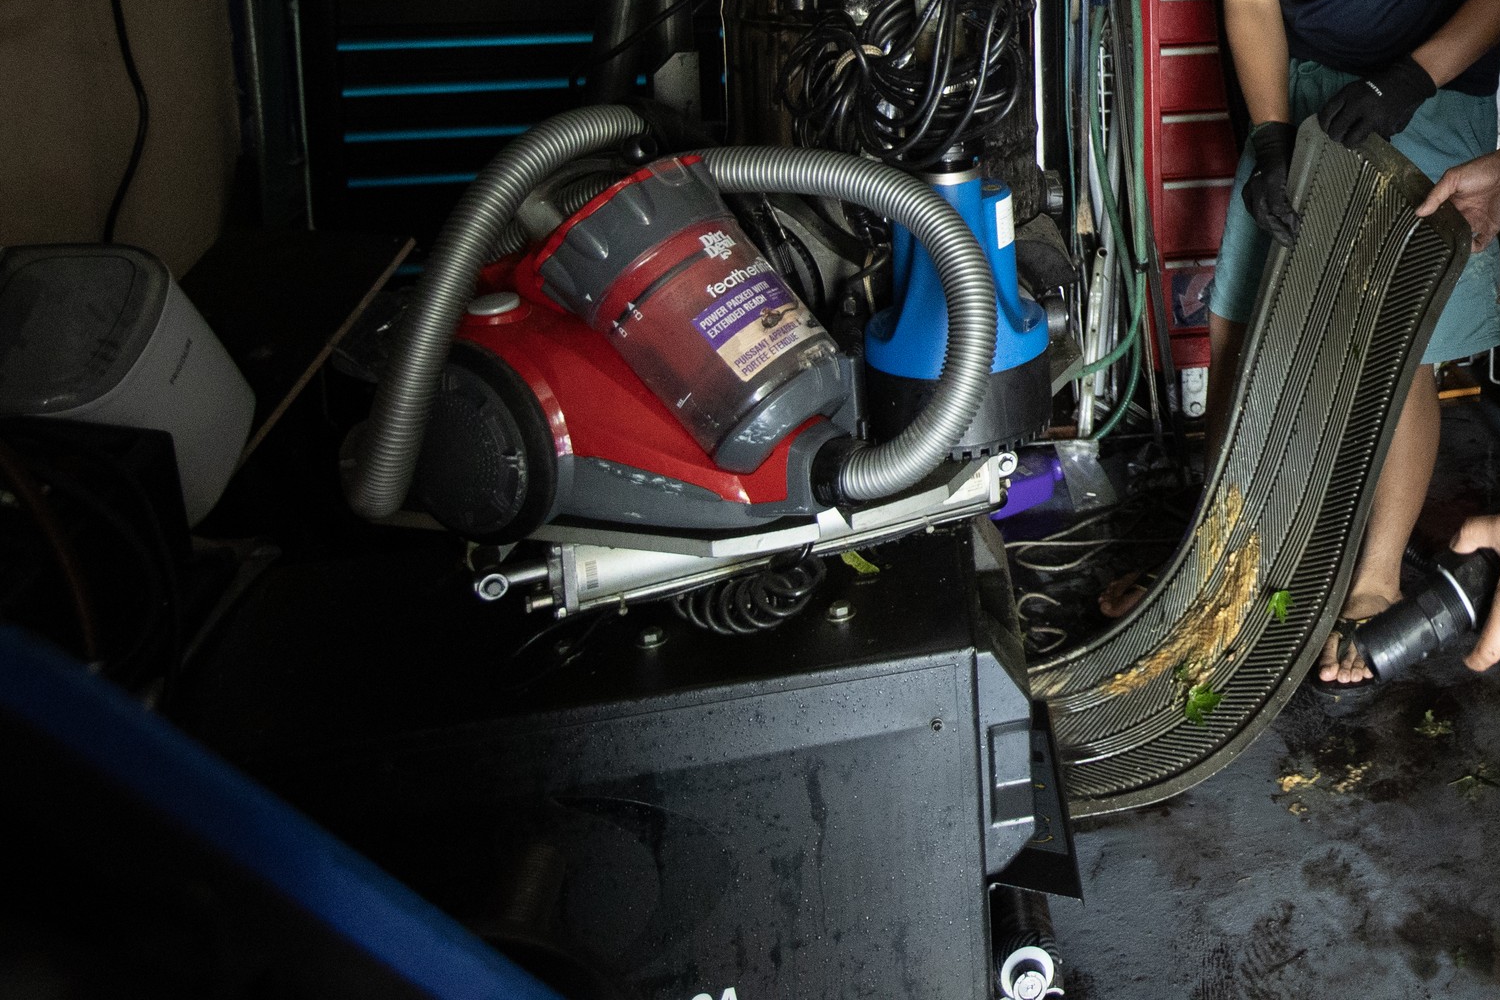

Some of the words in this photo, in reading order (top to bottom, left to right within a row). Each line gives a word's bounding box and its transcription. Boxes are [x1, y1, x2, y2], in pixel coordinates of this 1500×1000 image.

[699, 230, 726, 249] Dirt
[704, 235, 736, 259] Devil
[700, 305, 729, 330] POWER
[726, 288, 755, 310] PACKED
[751, 280, 770, 294] WITH
[707, 307, 746, 339] EXTENDED
[743, 294, 767, 312] REACH
[734, 338, 769, 368] PUISSANT
[769, 321, 798, 342] APPAREIL
